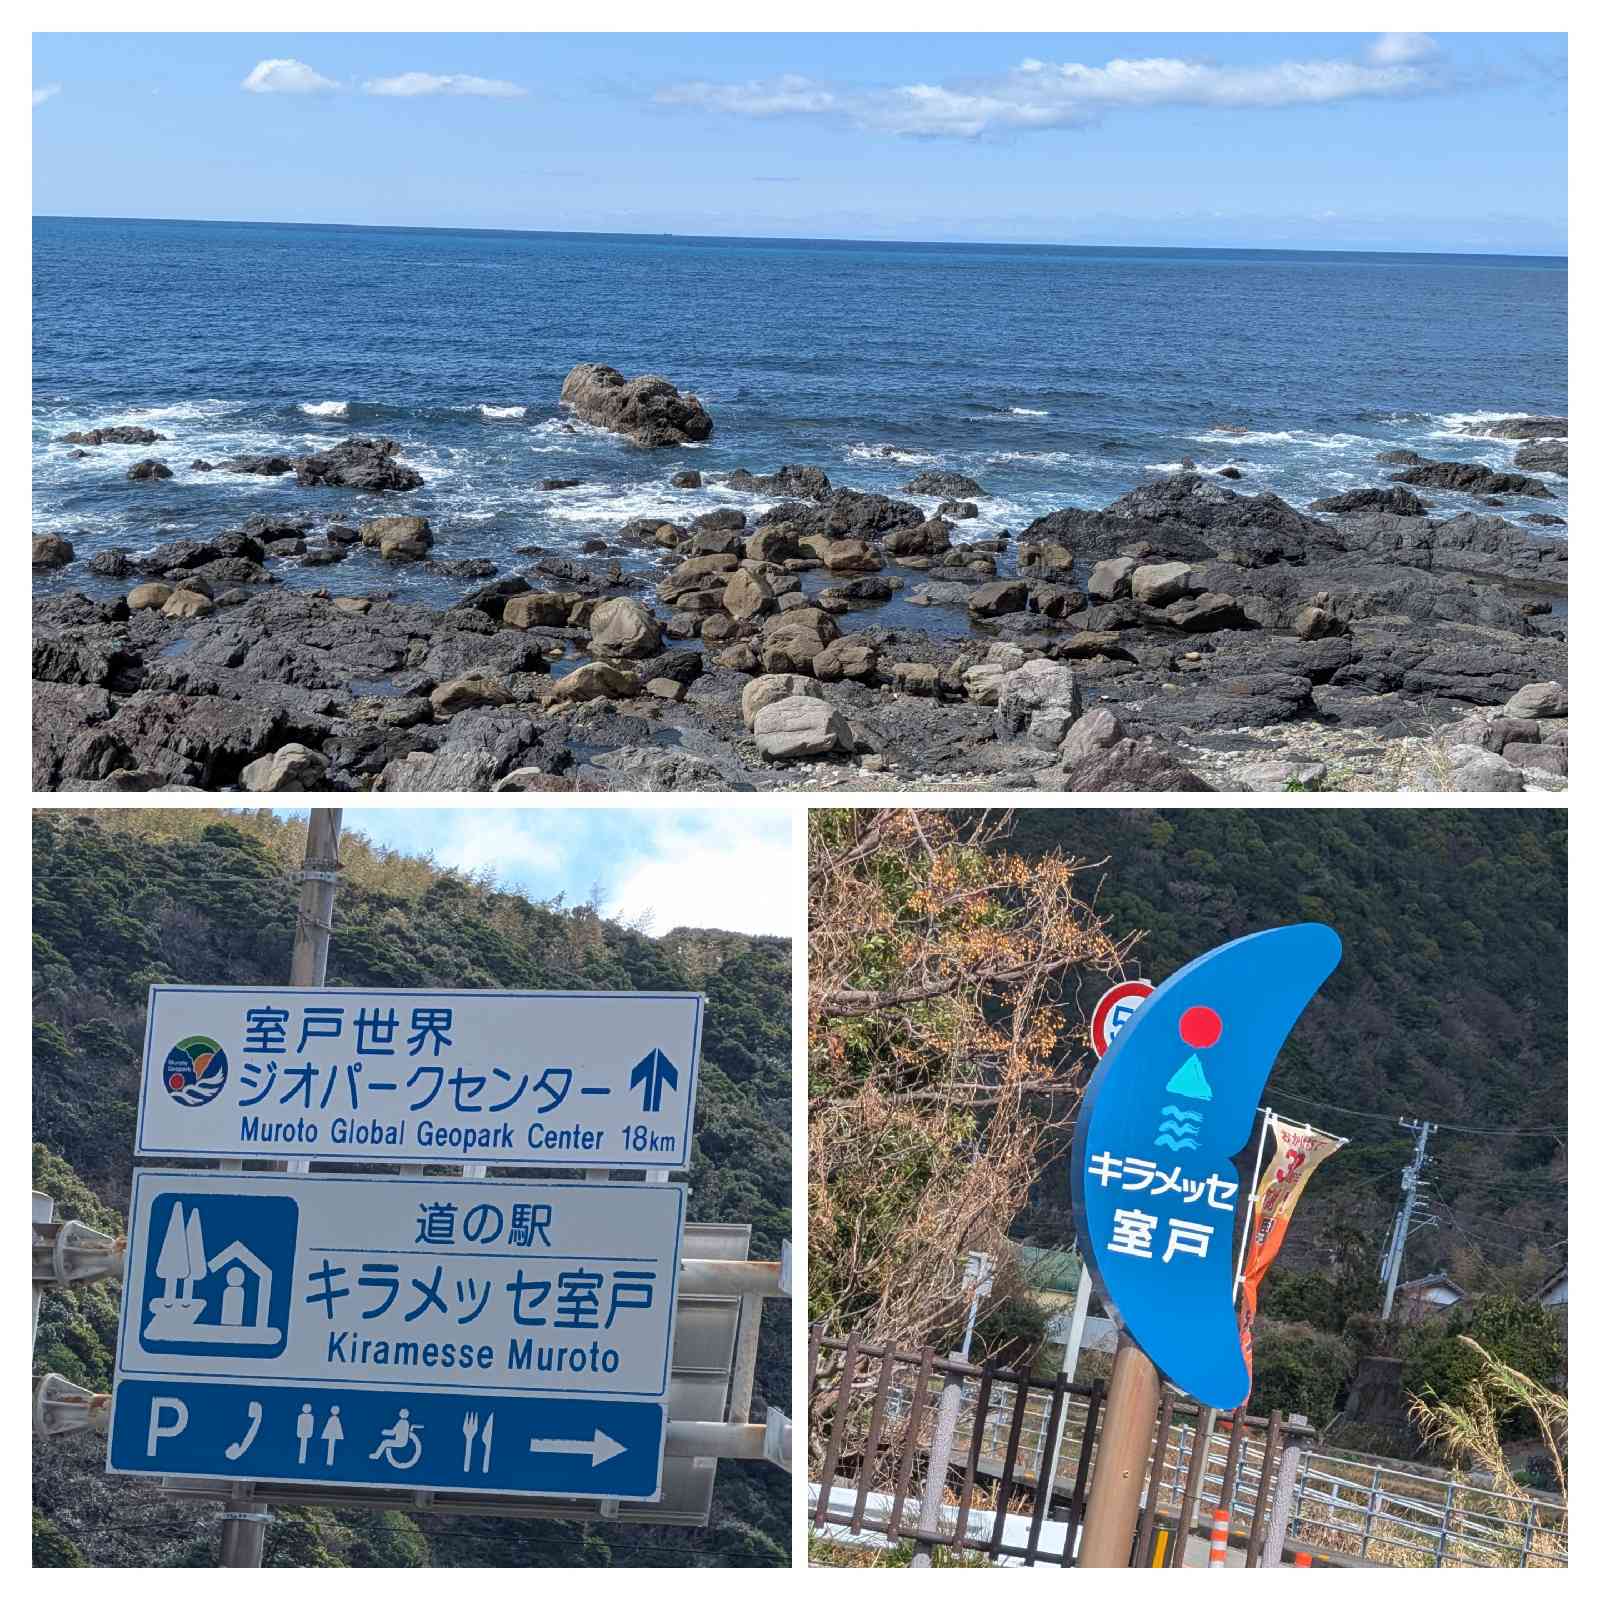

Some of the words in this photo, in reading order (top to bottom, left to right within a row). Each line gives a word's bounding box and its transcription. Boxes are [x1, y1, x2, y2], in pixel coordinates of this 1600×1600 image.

[242, 1006, 454, 1057] 室戸世界
[238, 1061, 611, 1114] ジオパークセンター
[240, 1116, 318, 1144] Muroto
[330, 1118, 405, 1146] Global
[417, 1121, 514, 1154] Geopark
[527, 1123, 604, 1150] Center
[1088, 1150, 1239, 1211] キラメッセ
[415, 1202, 553, 1247] 道の駅
[1107, 1208, 1214, 1263] 室戸
[305, 1259, 657, 1330] キラメッセ室戸
[327, 1331, 494, 1370] Kiramesse
[507, 1338, 620, 1374] Muroto
